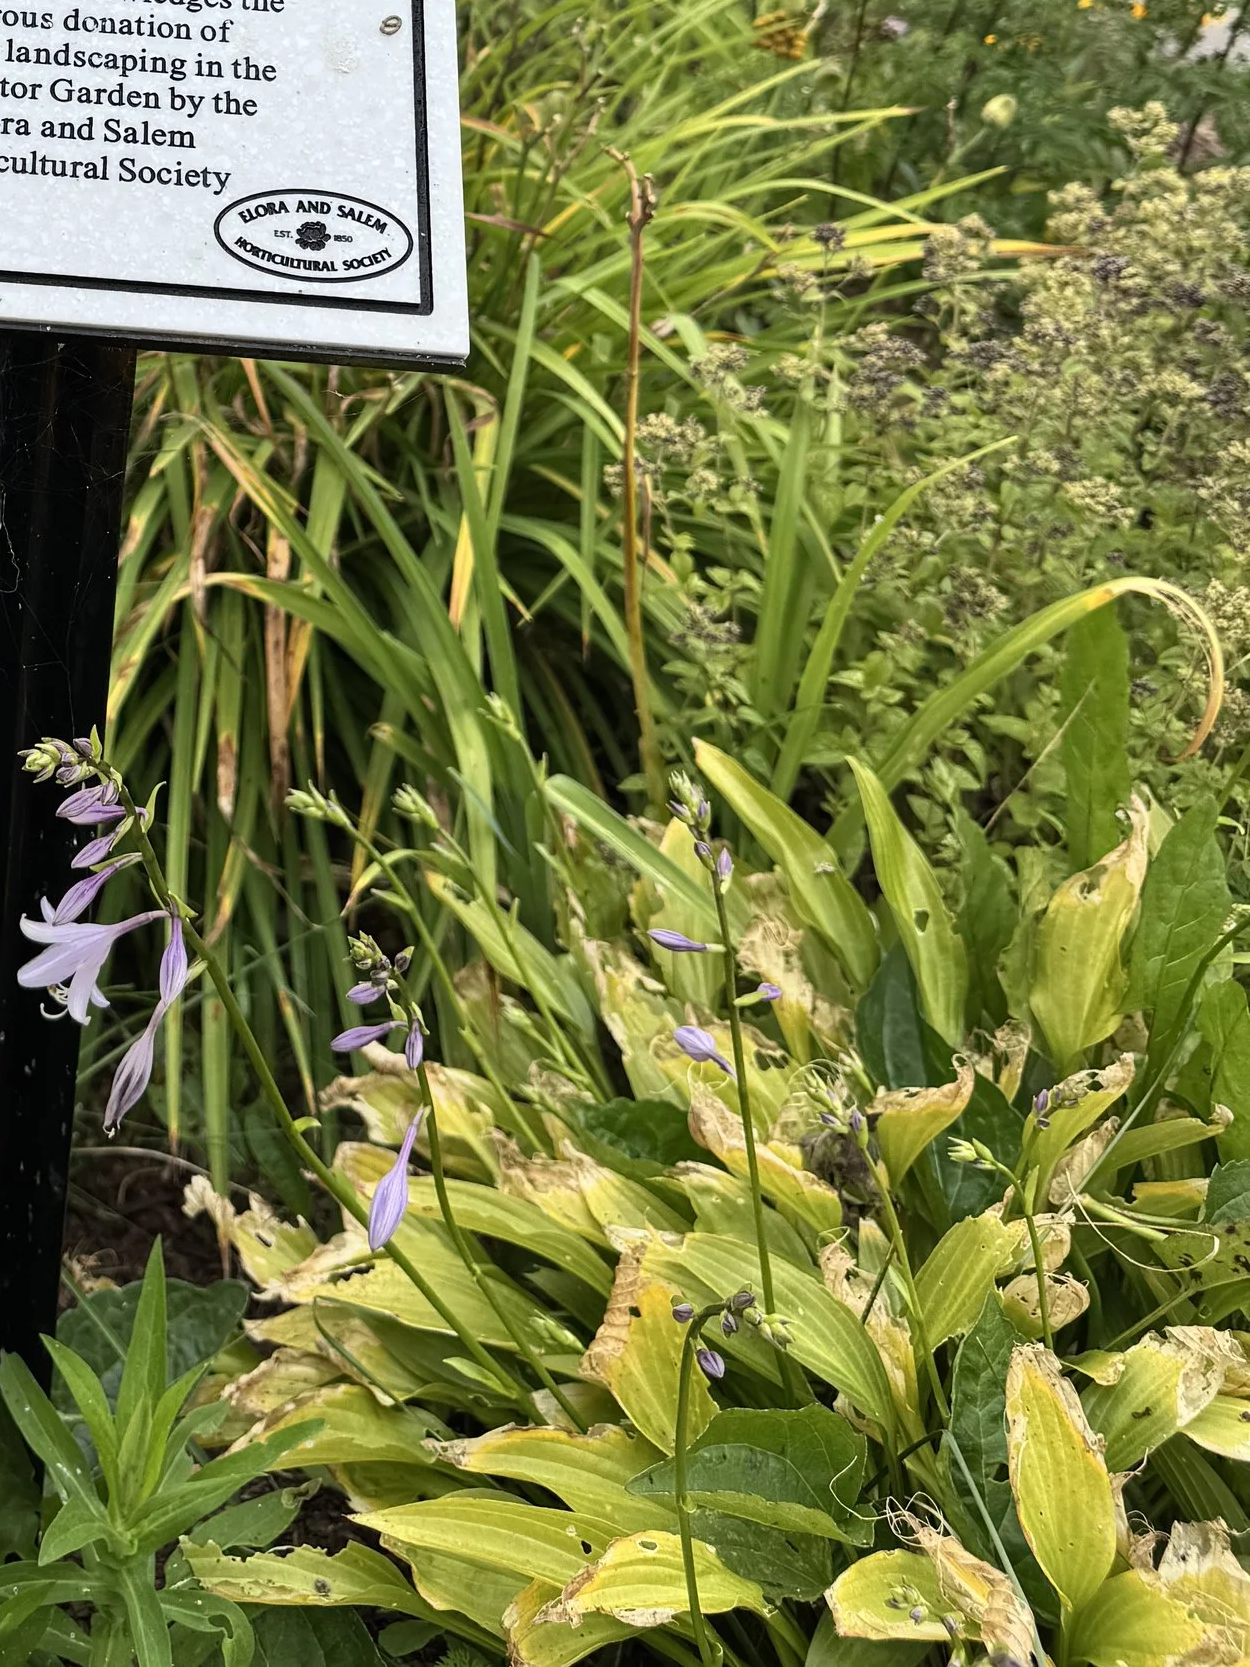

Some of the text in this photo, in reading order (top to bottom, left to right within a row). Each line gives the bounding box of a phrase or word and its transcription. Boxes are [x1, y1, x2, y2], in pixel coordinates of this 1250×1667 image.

[63, 8, 193, 40] donation
[200, 19, 235, 43] of
[5, 38, 188, 82] landscaping
[194, 52, 225, 78] in
[231, 56, 278, 82] the
[49, 78, 162, 110] Garden
[168, 86, 206, 119] by
[212, 90, 259, 117] the
[40, 116, 95, 142] and
[103, 118, 197, 149] Salem
[118, 157, 232, 196] Society
[237, 199, 388, 235] ELORA AND SALEM
[234, 236, 392, 272] HORTICULTURAL SOCIETY
[273, 229, 353, 244] EST. 1850
